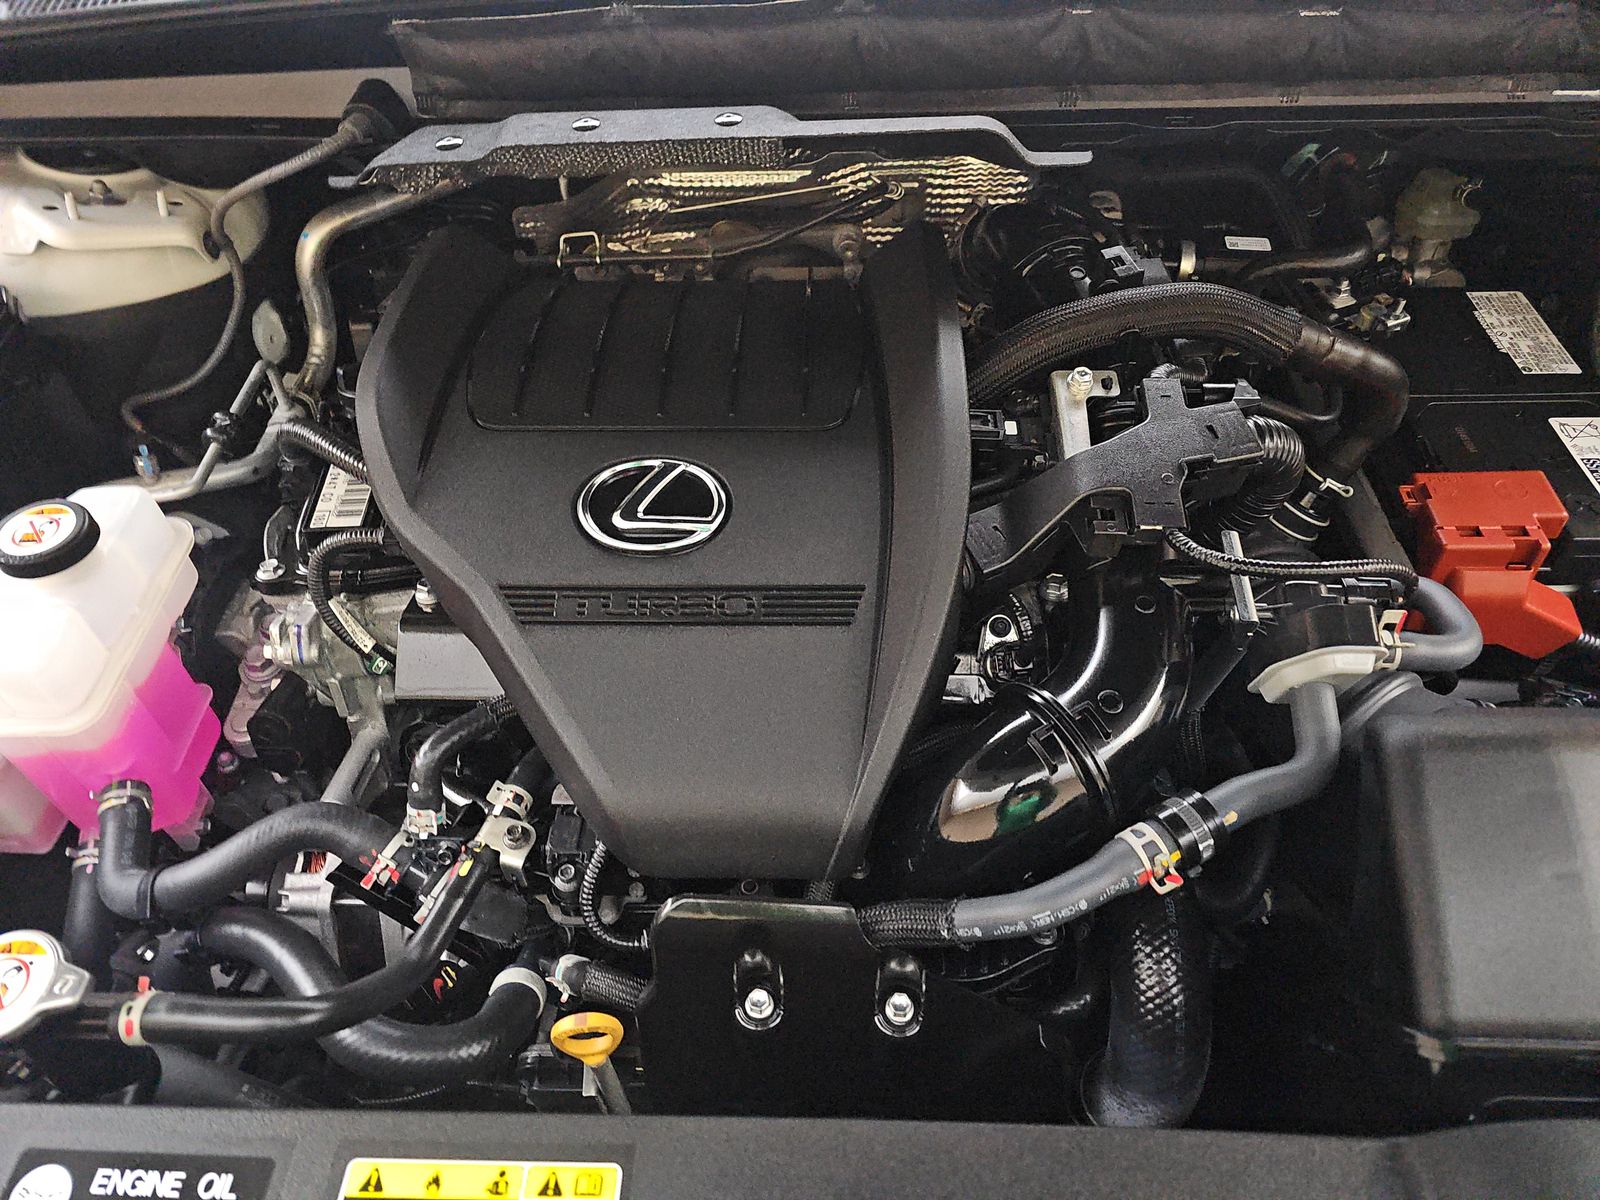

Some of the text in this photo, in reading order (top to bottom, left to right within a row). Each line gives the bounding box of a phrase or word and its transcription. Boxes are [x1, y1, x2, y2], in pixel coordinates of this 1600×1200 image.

[560, 592, 758, 618] TURBO
[89, 1167, 237, 1200] ENGINE OIL
